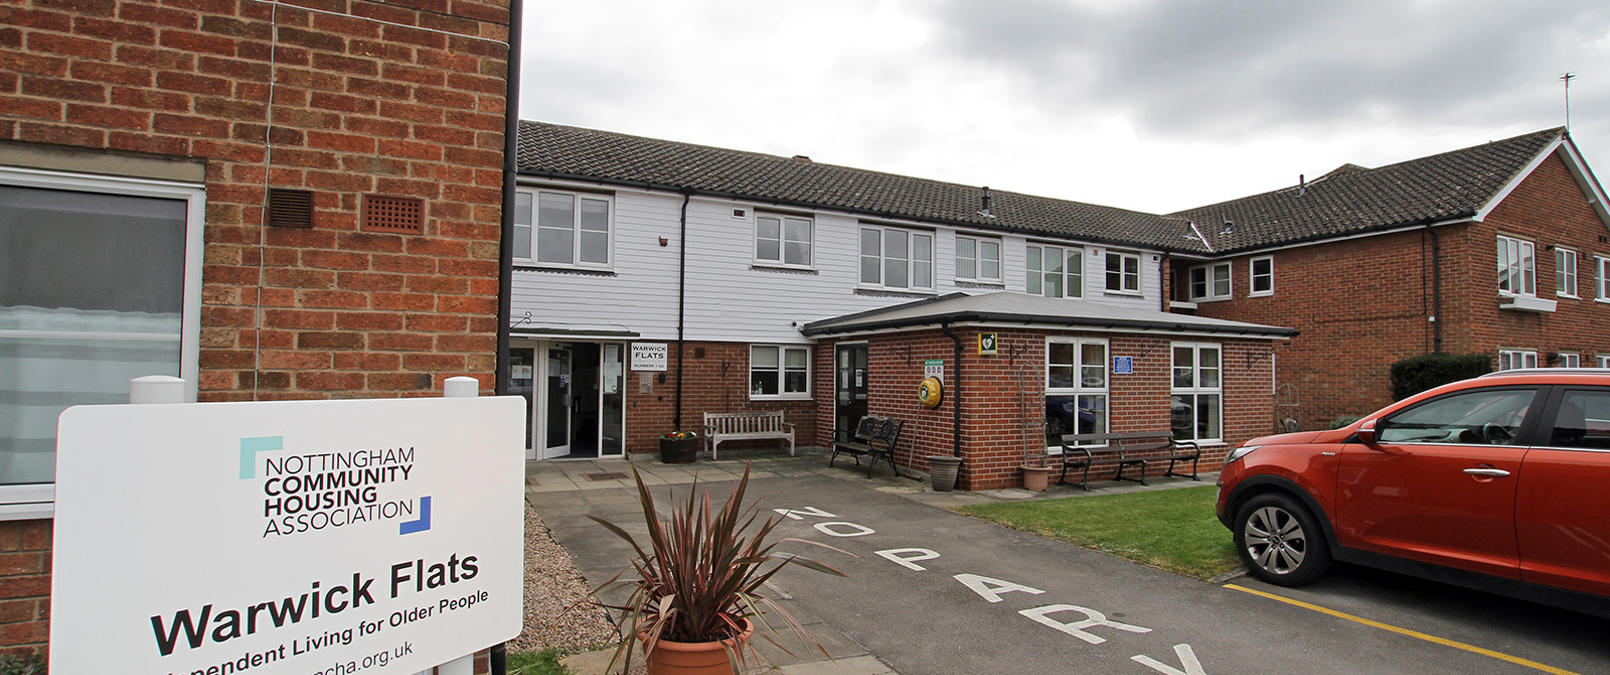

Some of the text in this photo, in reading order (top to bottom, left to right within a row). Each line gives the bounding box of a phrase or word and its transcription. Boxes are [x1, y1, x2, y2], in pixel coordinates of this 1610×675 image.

[266, 447, 414, 476] NOTTINGHAM
[264, 464, 413, 496] COMMUNITY
[263, 499, 413, 538] ASSOCIATION
[265, 487, 377, 517] HOUSING
[150, 553, 479, 657] Warwick Flats
[293, 628, 353, 657] Living
[359, 619, 384, 637] for
[389, 605, 434, 628] Older
[439, 590, 489, 614] People
